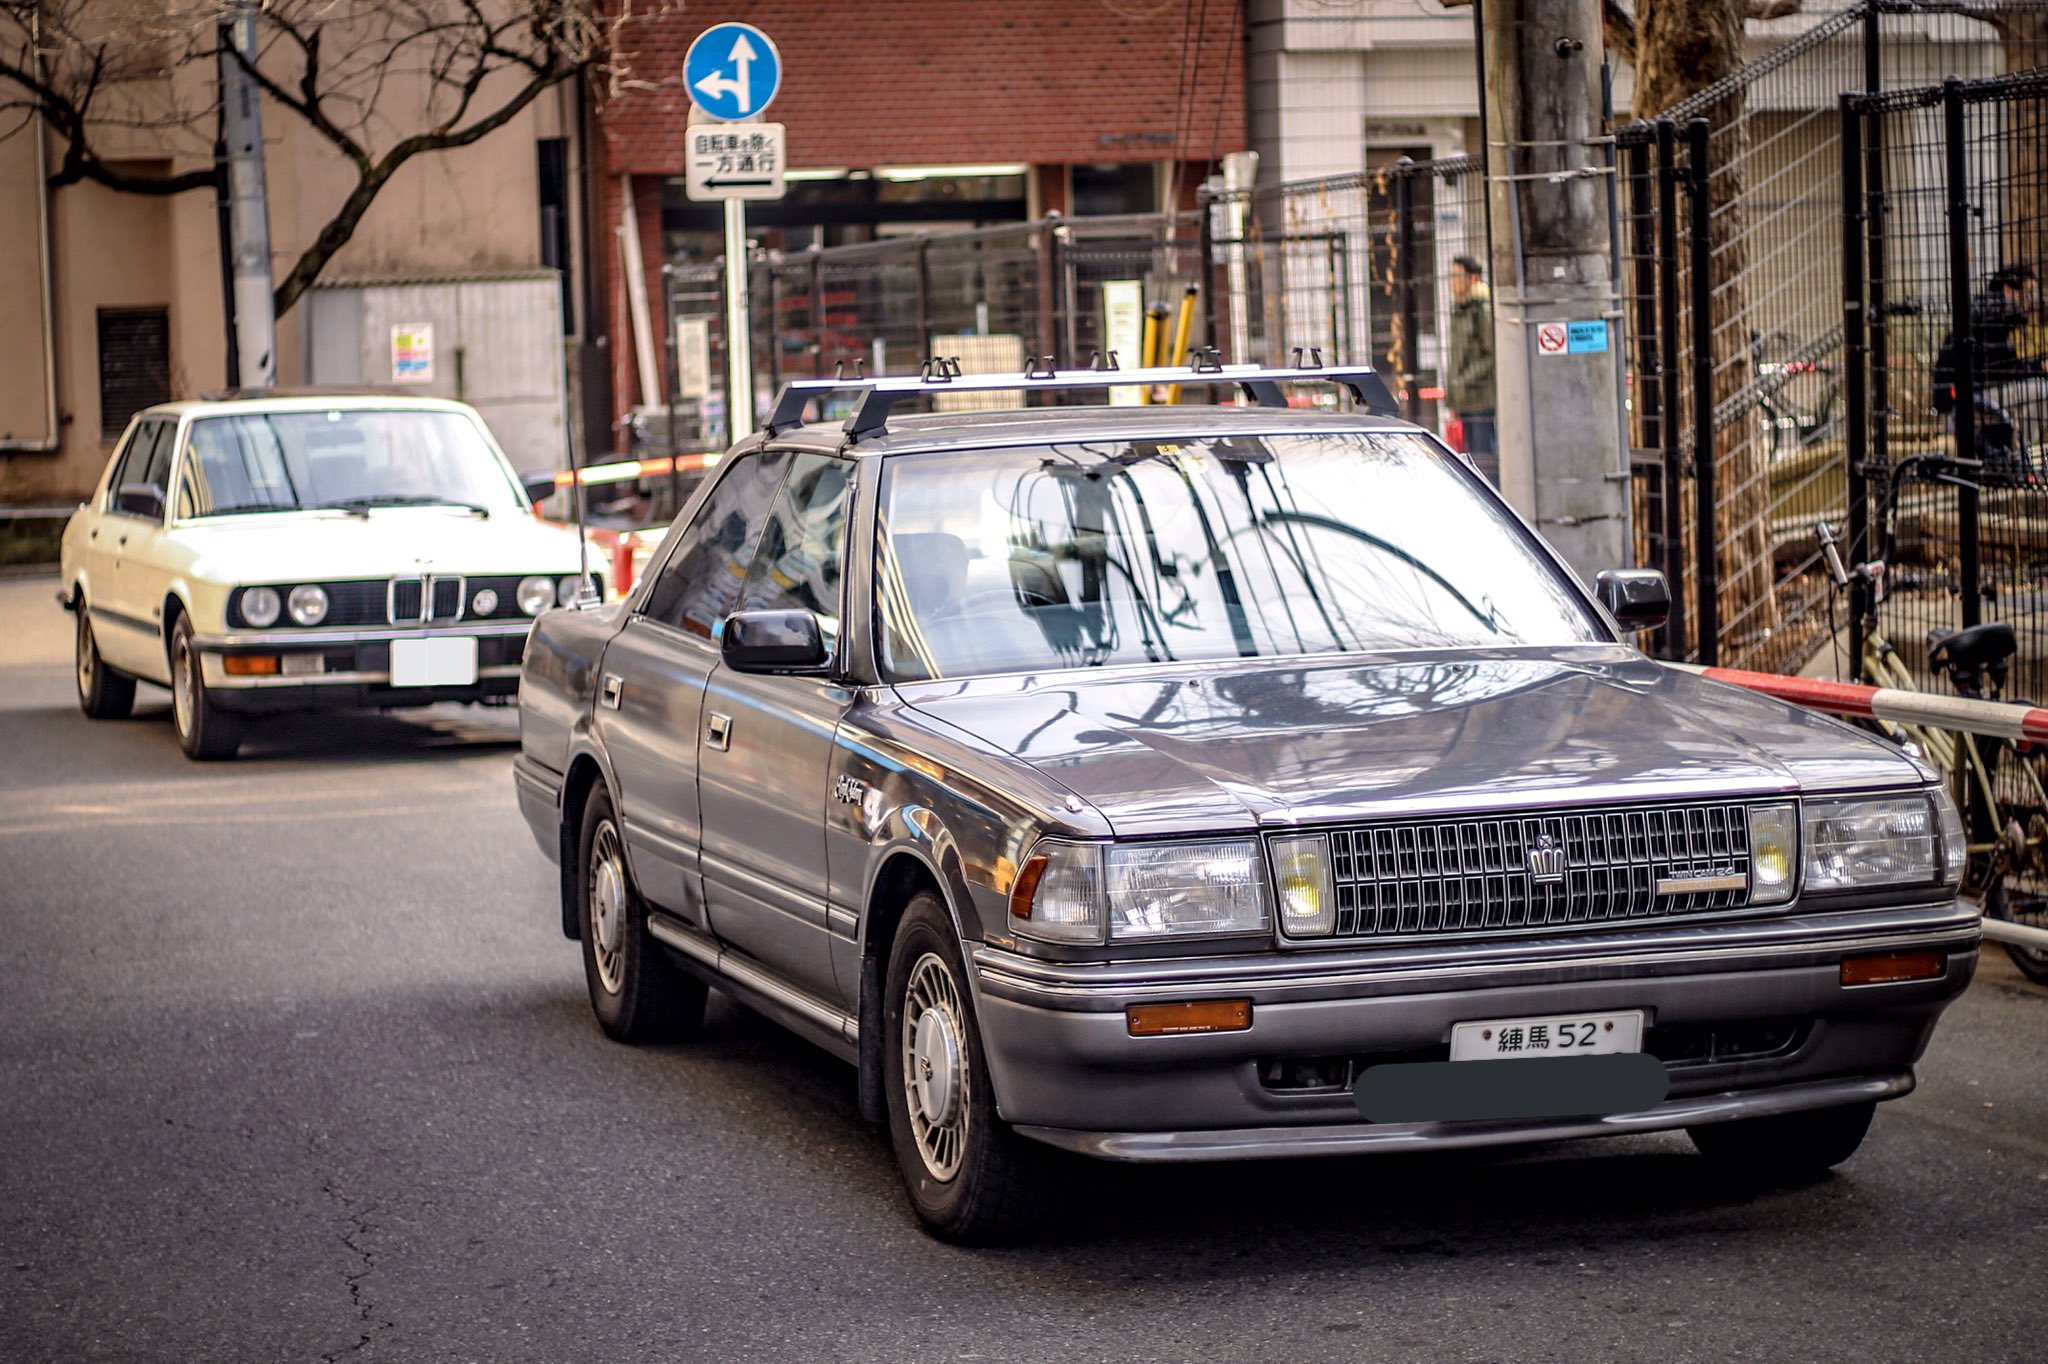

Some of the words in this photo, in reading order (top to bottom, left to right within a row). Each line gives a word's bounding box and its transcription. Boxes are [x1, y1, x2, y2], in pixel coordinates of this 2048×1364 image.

[694, 133, 775, 155] 自転車を除く
[694, 154, 775, 173] 一方通行
[1669, 870, 1693, 879] TWIN
[1693, 868, 1715, 878] CAM
[1497, 1025, 1551, 1052] 練馬
[1558, 1022, 1597, 1048] 52
